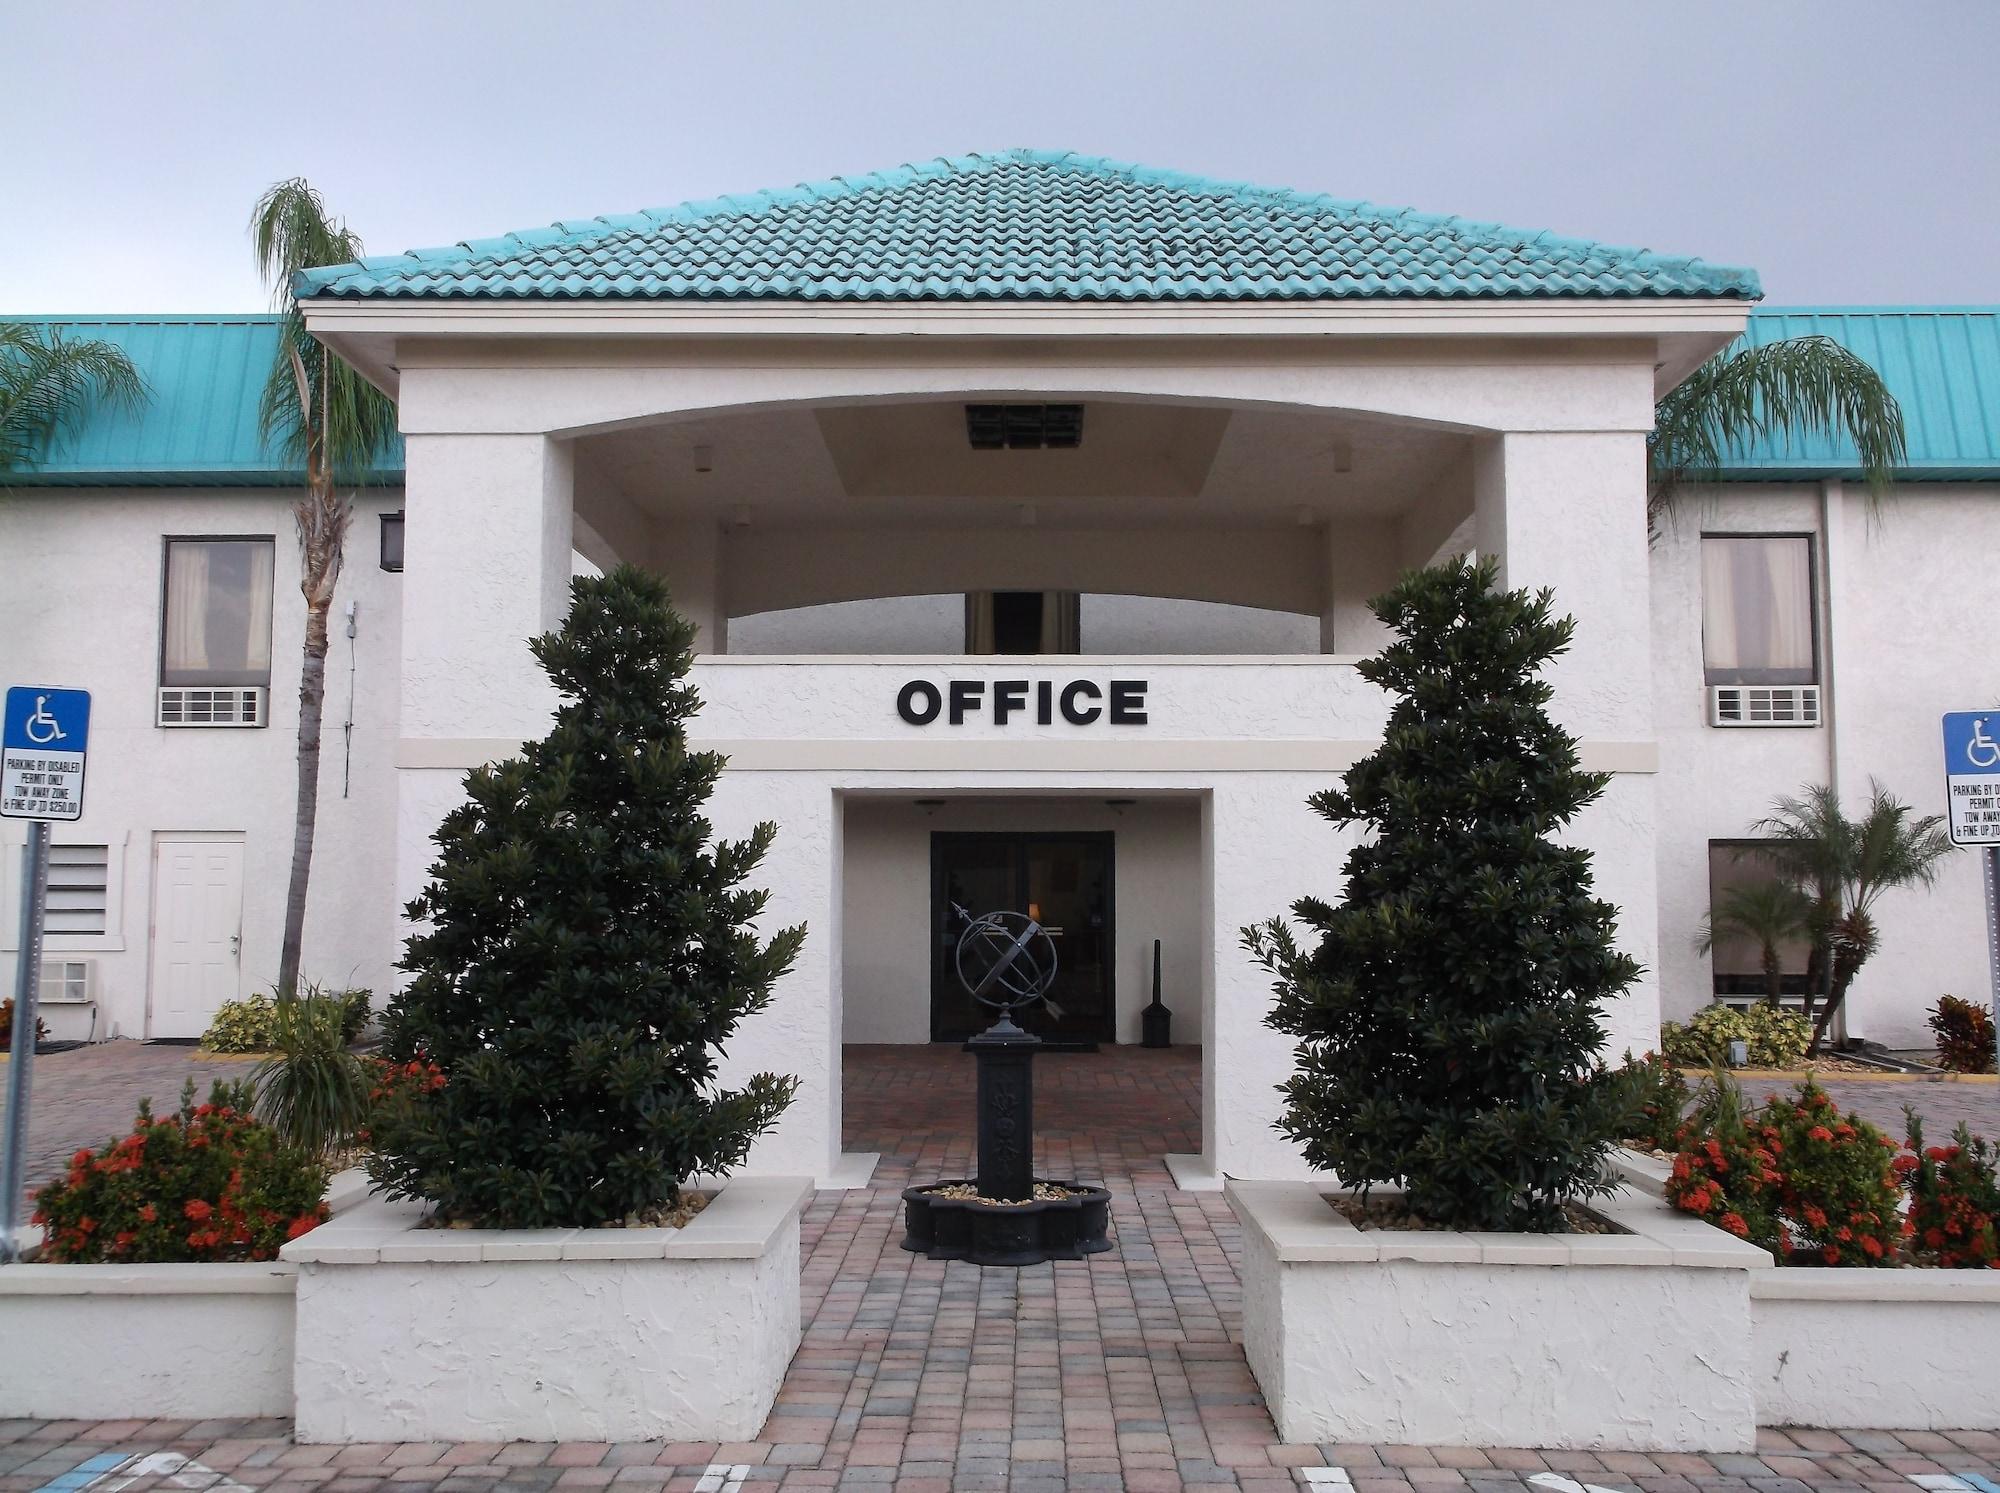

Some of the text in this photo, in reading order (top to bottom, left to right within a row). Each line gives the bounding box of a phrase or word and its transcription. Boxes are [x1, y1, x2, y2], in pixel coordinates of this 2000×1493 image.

[896, 679, 1148, 726] OFFICE
[7, 759, 80, 773] PARKING BY DISABLED
[22, 772, 64, 786] PERMIT ONLY
[14, 786, 69, 800] TOW AWAY ZONE
[1954, 784, 1982, 796] PARKING
[1984, 784, 1992, 795] BY
[11, 798, 26, 810] FINE
[28, 800, 36, 810] UP
[49, 802, 78, 813] $250.00
[1970, 798, 1994, 809] PERMIT
[1964, 812, 1979, 822] TOW
[1956, 826, 1961, 836] &
[1964, 826, 1978, 836] FINE
[1981, 825, 1989, 836] UP
